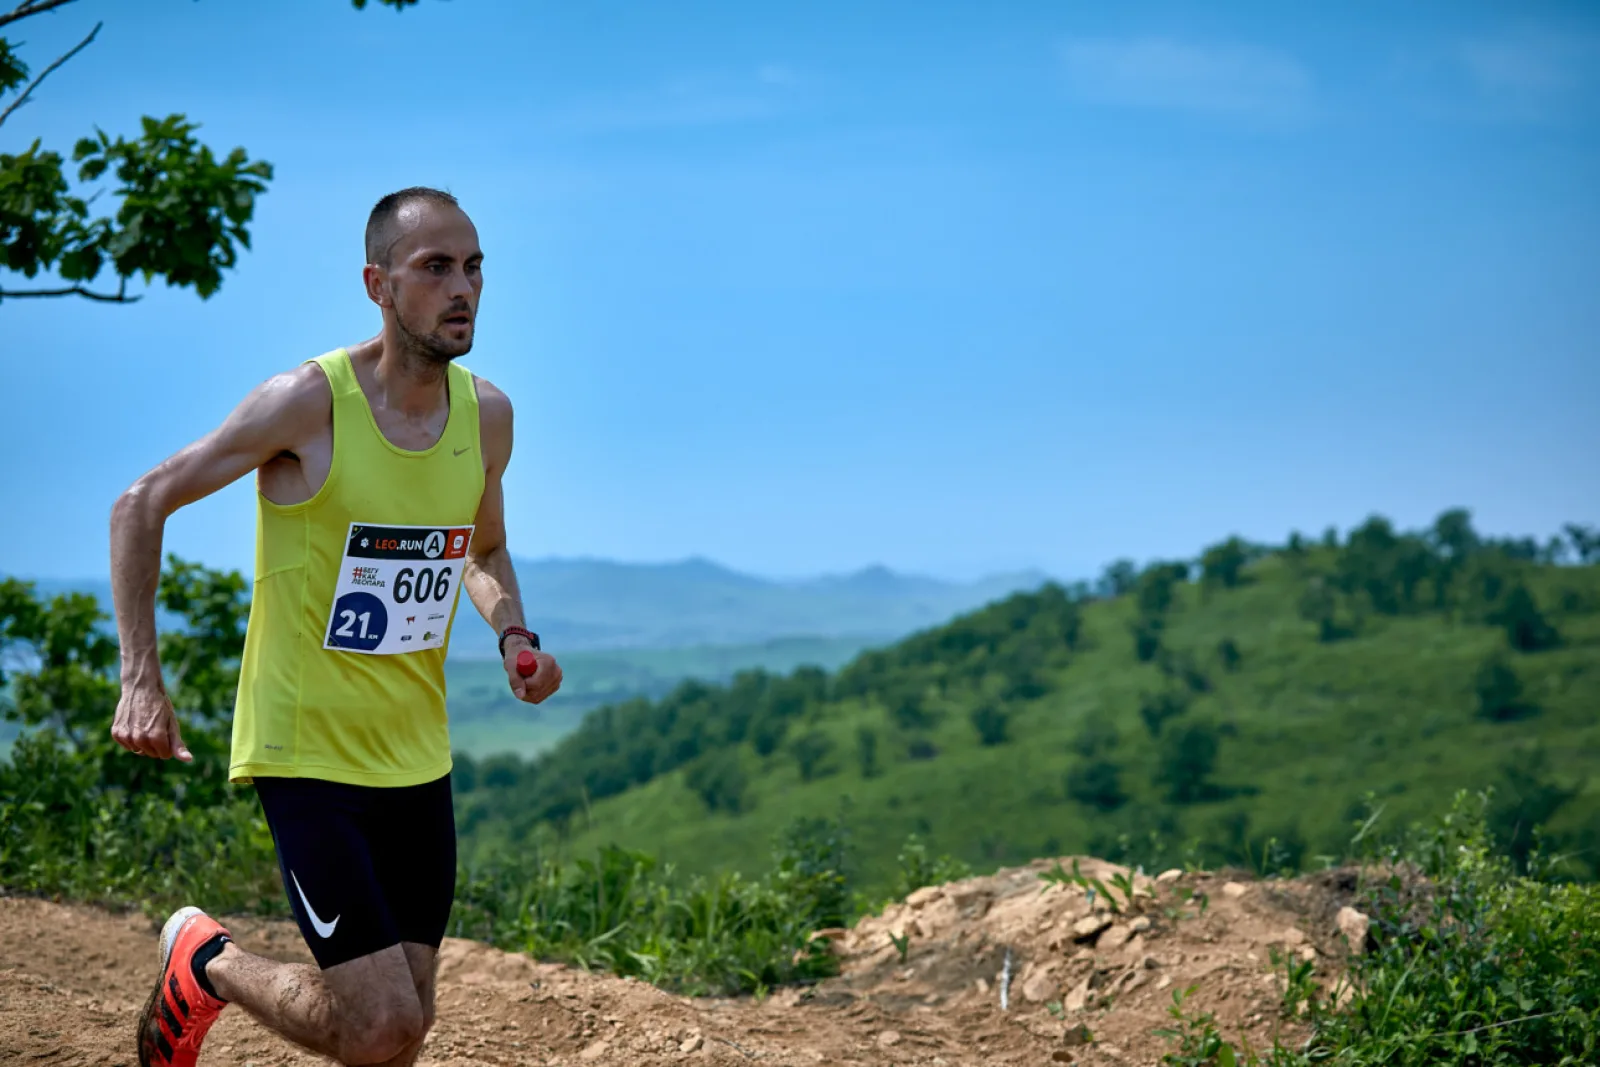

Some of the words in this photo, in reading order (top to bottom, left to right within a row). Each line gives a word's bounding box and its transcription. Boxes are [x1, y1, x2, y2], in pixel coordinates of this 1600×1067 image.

[375, 538, 423, 551] LEO.RUN
[392, 566, 452, 604] 606
[335, 609, 371, 639] 21
